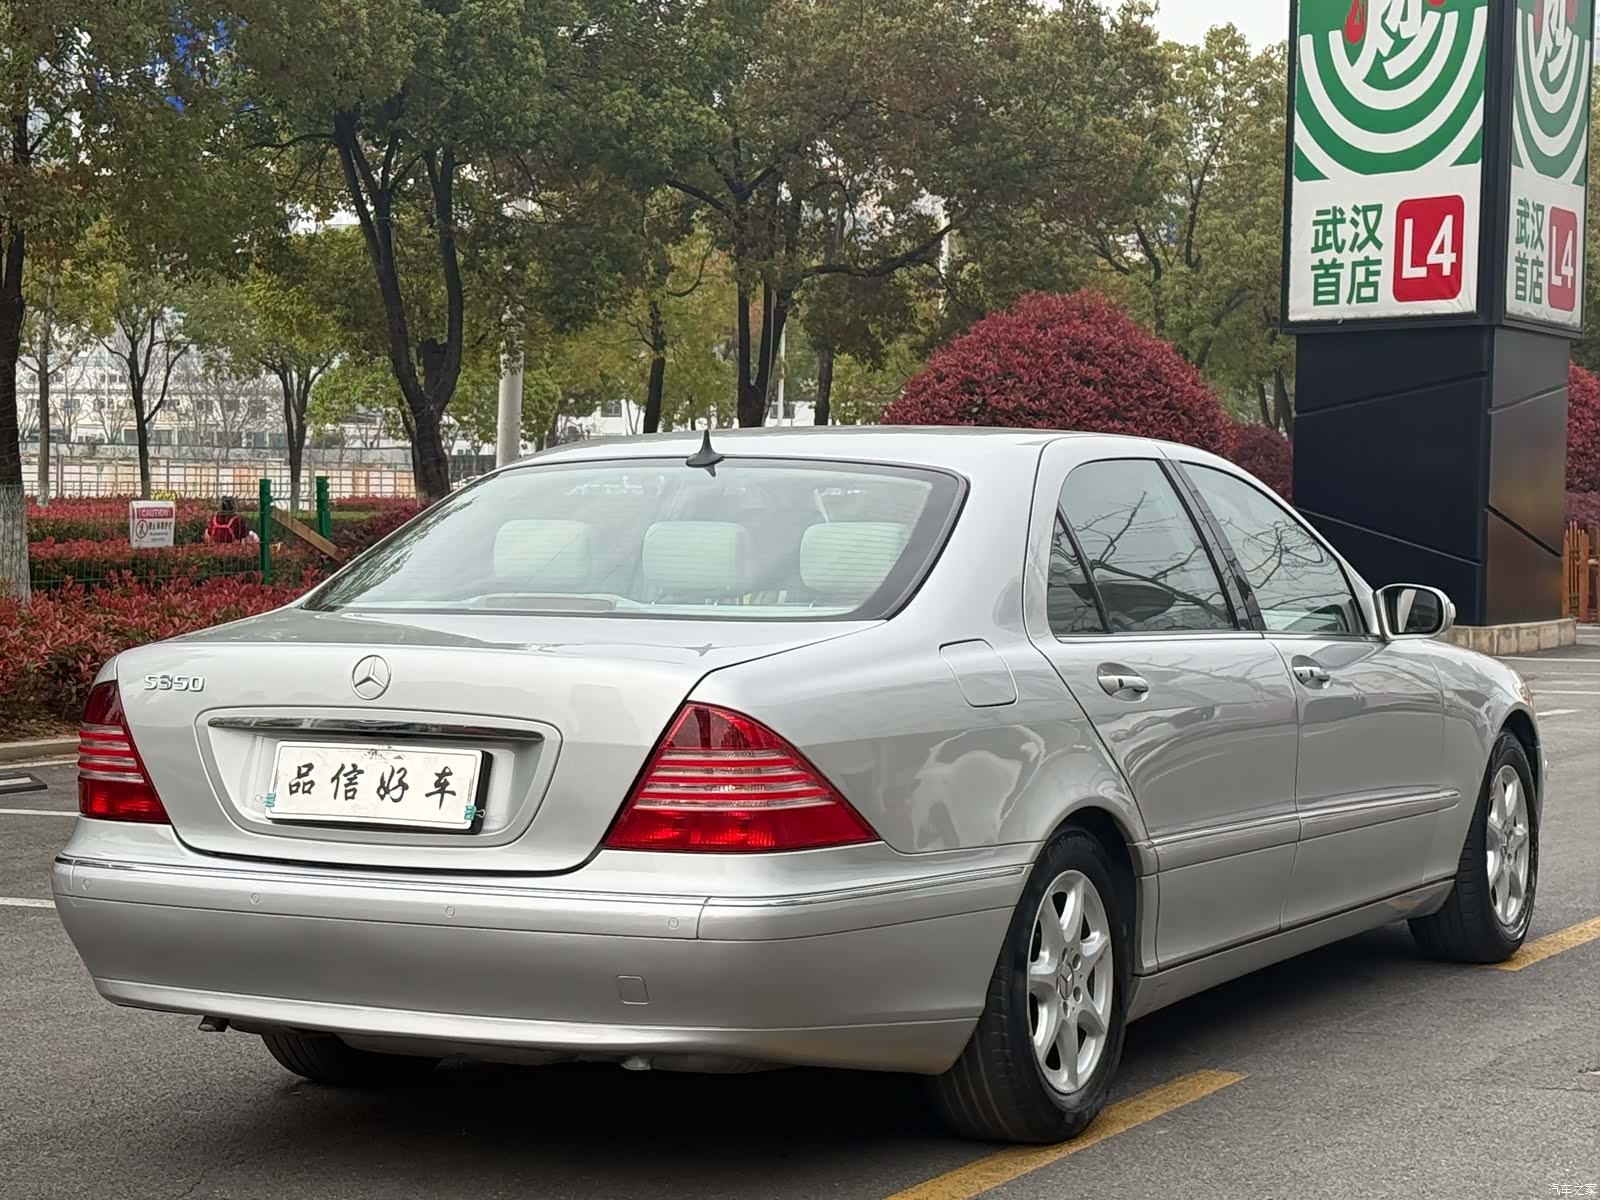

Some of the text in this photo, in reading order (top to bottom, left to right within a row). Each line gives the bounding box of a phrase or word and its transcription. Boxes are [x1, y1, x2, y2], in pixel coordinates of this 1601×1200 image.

[1311, 203, 1384, 254] 武汉
[1401, 214, 1457, 279] L4
[1515, 197, 1545, 252] 武汉
[1310, 256, 1383, 306] 首店
[1515, 250, 1544, 304] 首店
[1551, 225, 1574, 289] L4
[141, 508, 172, 517] CAUTION
[143, 674, 206, 693] S350
[287, 762, 457, 810] 品信好车
